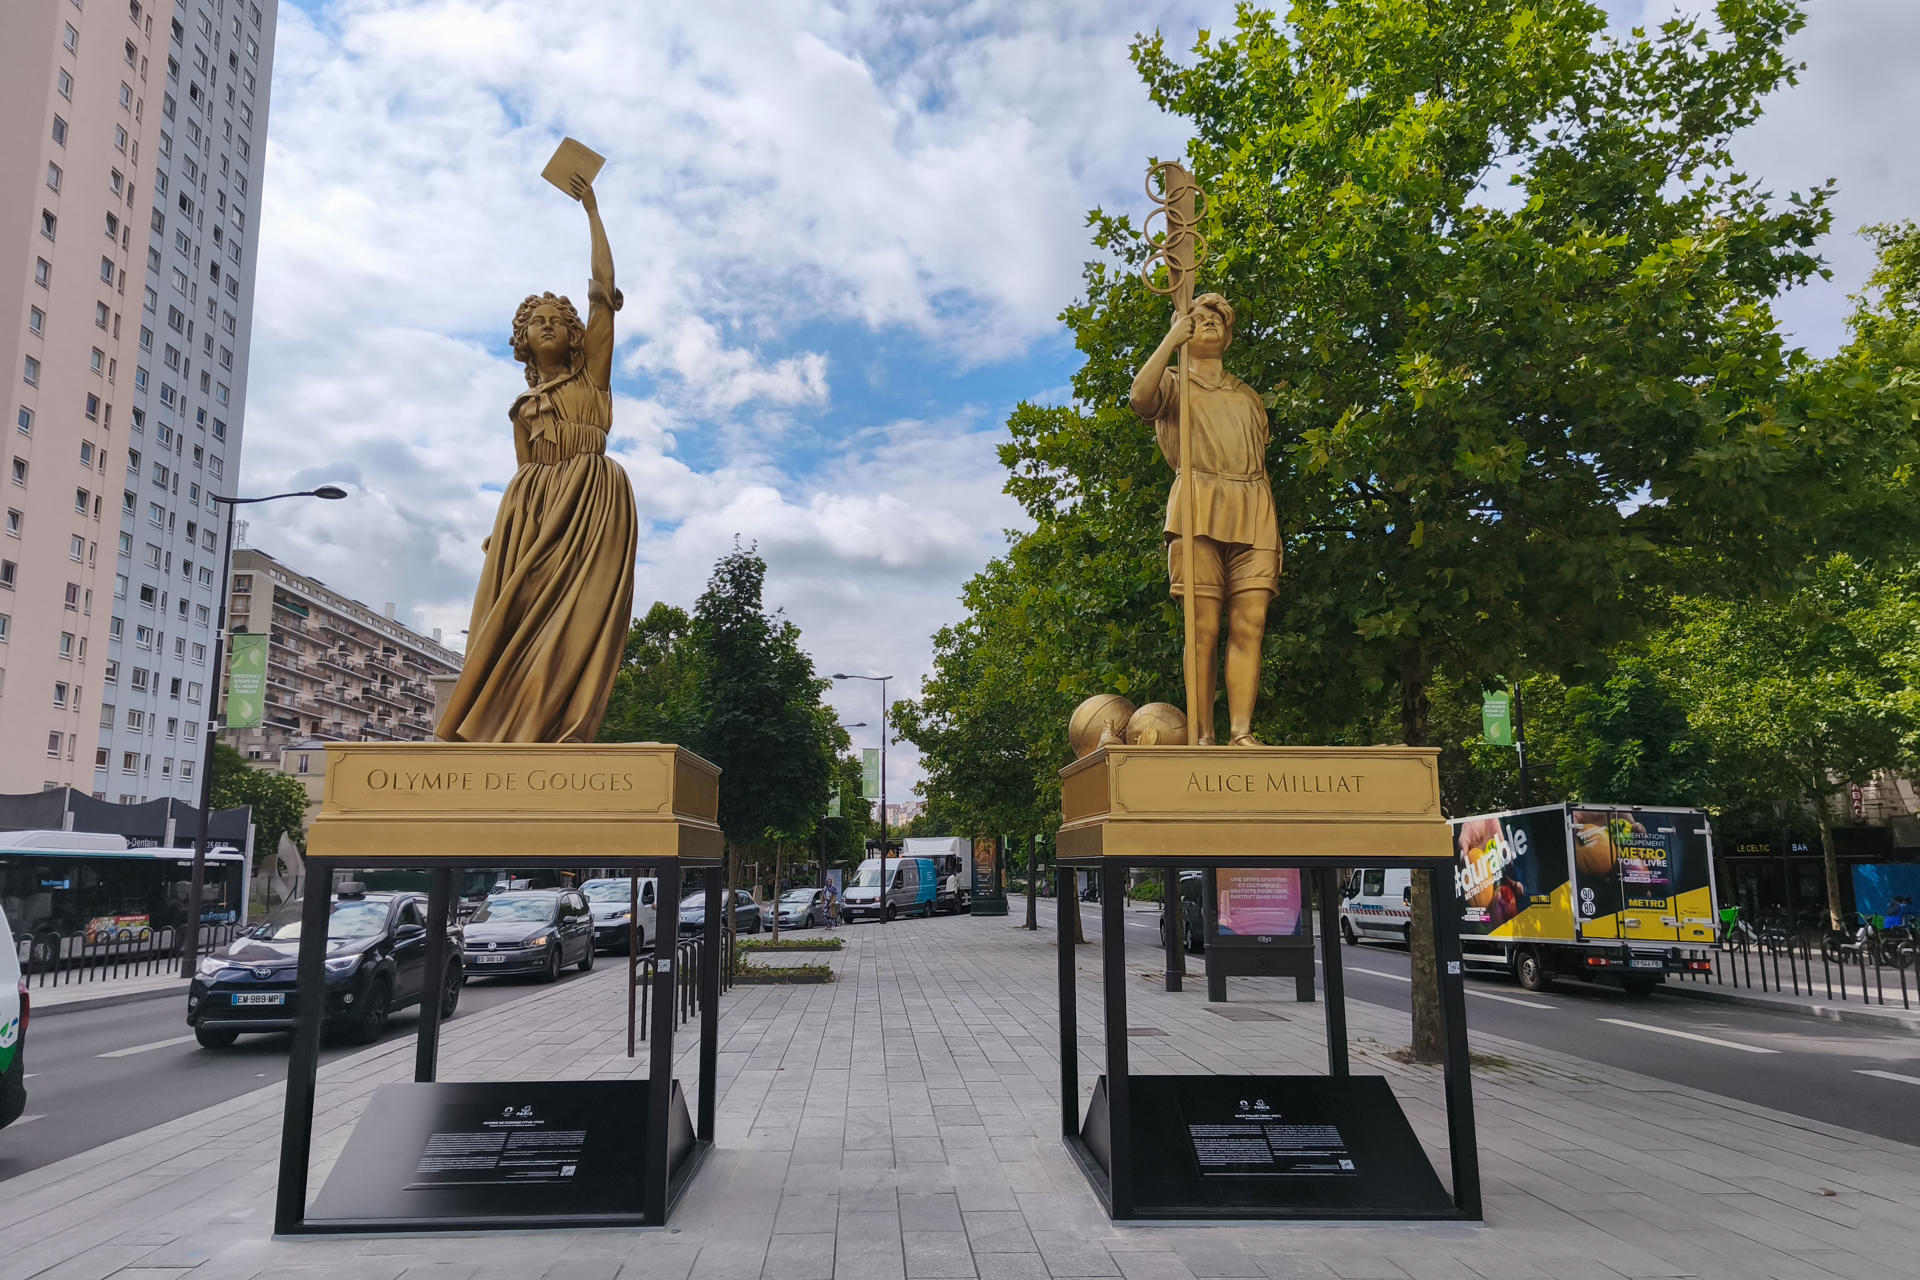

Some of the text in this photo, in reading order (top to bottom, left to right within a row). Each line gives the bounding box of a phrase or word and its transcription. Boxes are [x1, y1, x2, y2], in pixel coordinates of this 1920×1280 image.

[366, 768, 634, 791] OLYMPE DE GOUGES
[1186, 771, 1366, 793] ALICE MILLIAT
[1851, 782, 1862, 816] ABAC
[1454, 823, 1528, 899] #durable
[1618, 847, 1666, 860] METRO
[1643, 859, 1668, 868] LIVRE
[1582, 889, 1593, 900] 90
[1628, 899, 1666, 908] METRO
